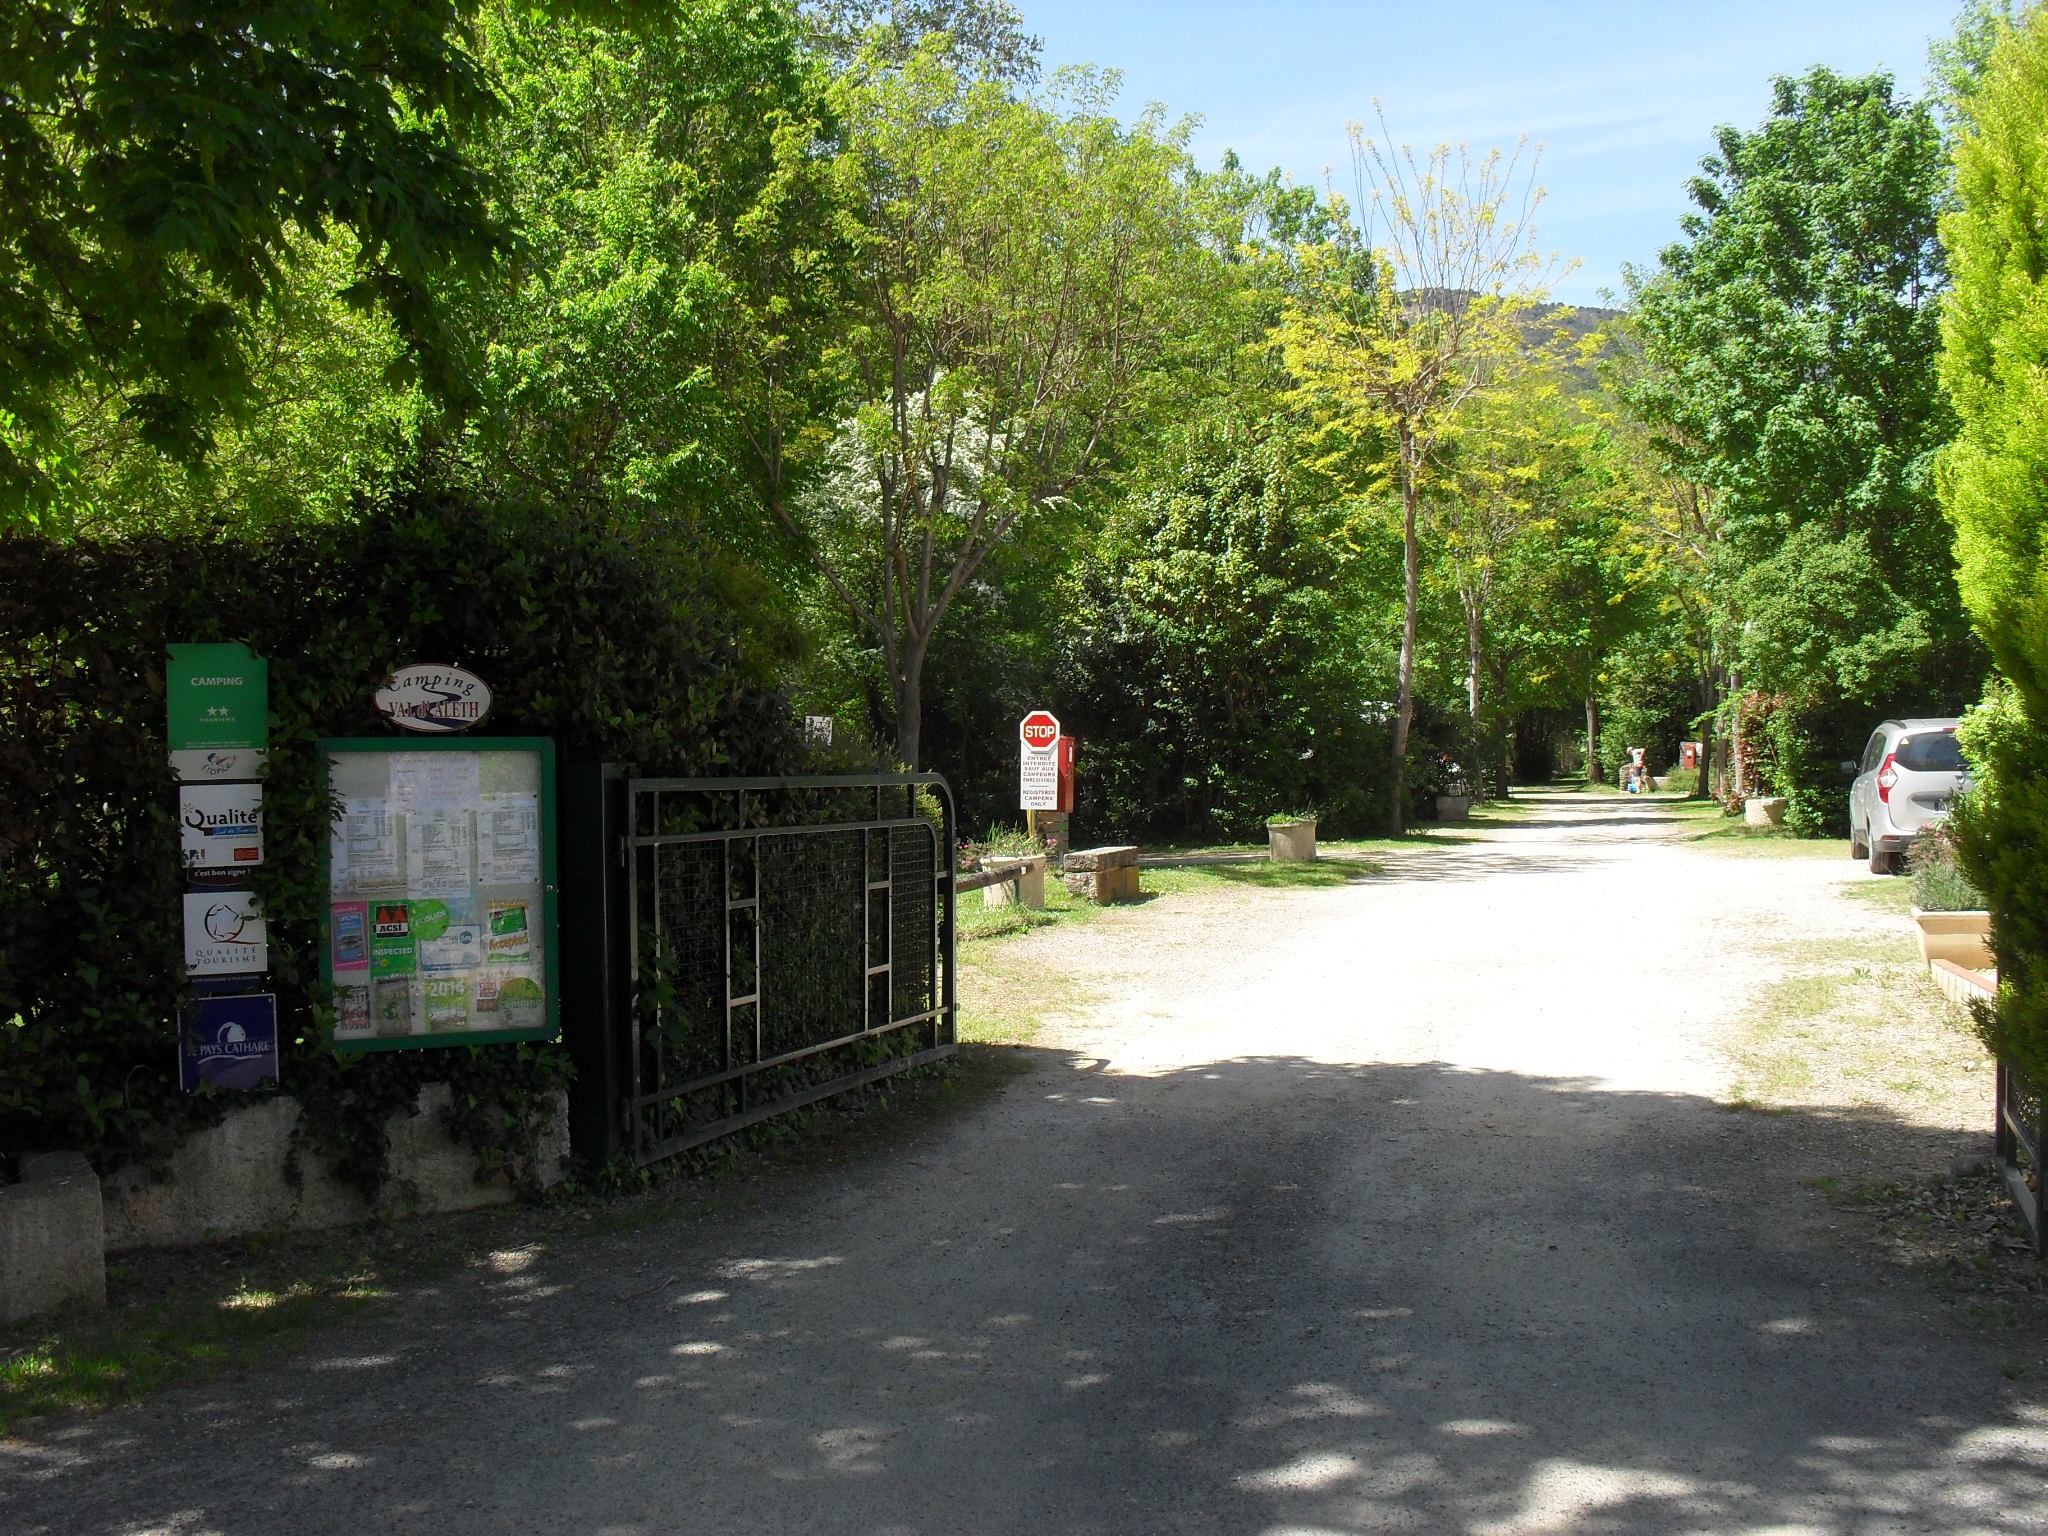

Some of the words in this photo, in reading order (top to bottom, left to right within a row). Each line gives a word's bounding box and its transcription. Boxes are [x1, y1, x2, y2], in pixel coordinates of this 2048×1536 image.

[191, 677, 243, 686] CAMPING
[388, 701, 415, 718] VAL
[1025, 725, 1055, 738] STOP
[185, 808, 258, 832] Qualité
[194, 869, 211, 877] c'est
[211, 868, 227, 876] bon
[227, 868, 247, 877] signe
[379, 924, 402, 933] ACSI
[372, 947, 413, 956] INSPECTED
[196, 956, 257, 965] TOURISME
[430, 981, 465, 998] 2014
[200, 1043, 223, 1056] PAYS
[224, 1040, 270, 1053] CATHARE
